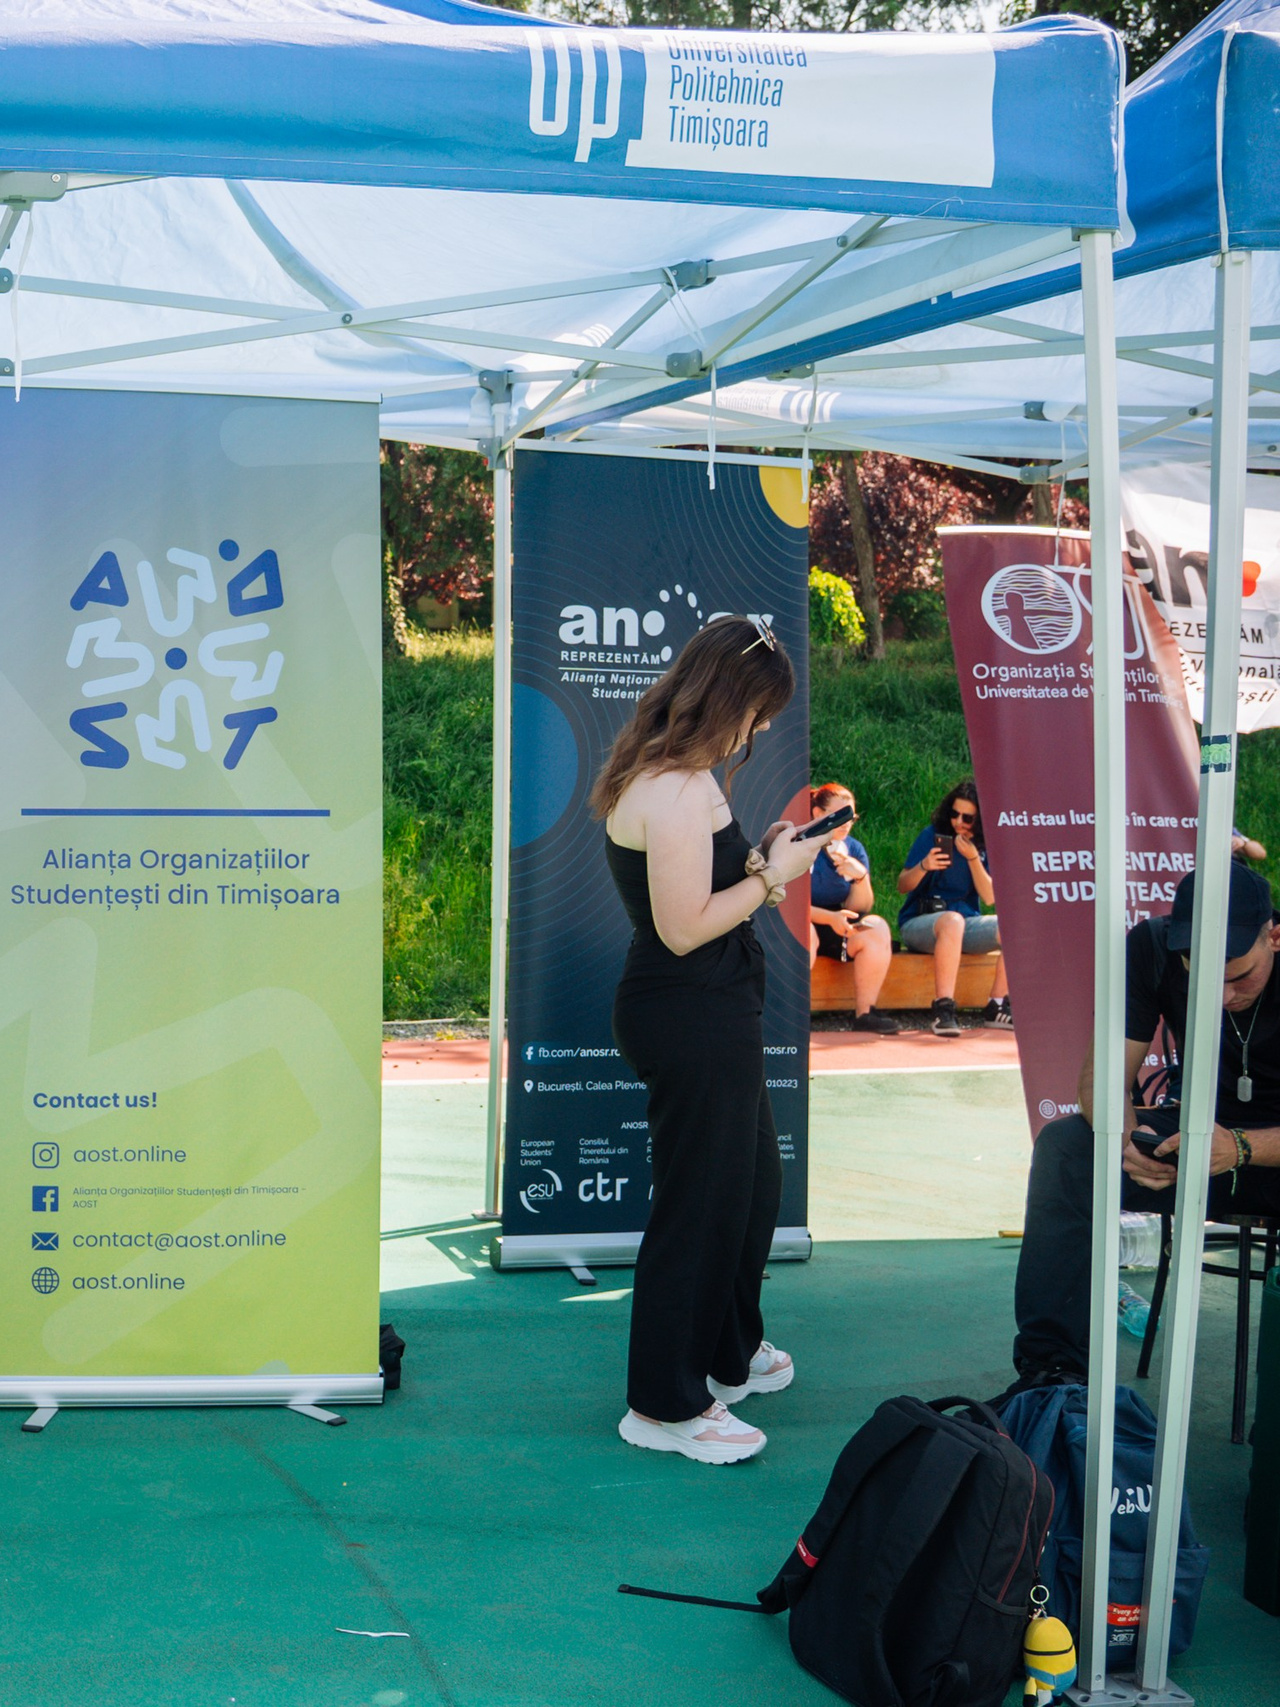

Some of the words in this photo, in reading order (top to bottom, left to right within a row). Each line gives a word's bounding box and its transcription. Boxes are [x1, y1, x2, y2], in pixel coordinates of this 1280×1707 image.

[670, 64, 784, 107] Politehnica
[669, 106, 768, 151] Timișoara
[561, 651, 660, 664] REPREZENTĂM
[561, 672, 605, 685] Alianța
[610, 673, 663, 687] Naționa
[973, 663, 1075, 681] Organizația
[976, 684, 1068, 699] Universitatea
[1072, 684, 1089, 697] de
[997, 811, 1028, 826] Aici
[1032, 812, 1066, 826] stau
[1131, 812, 1146, 827] în
[1149, 815, 1178, 827] care
[43, 849, 131, 875] Alianța
[140, 849, 310, 876] Organizațiilor
[11, 884, 159, 911] Studențești
[168, 884, 208, 905] din
[217, 884, 340, 910] Timișoara
[586, 1080, 613, 1091] Calea
[615, 1079, 647, 1090] Plevne
[766, 1079, 798, 1089] 010223
[33, 1092, 120, 1109] Contact
[125, 1092, 157, 1108] us!
[621, 1121, 649, 1129] ANOSR
[520, 1140, 555, 1149] European
[579, 1138, 609, 1146] Consiliul
[73, 1145, 187, 1163] aost.online
[520, 1158, 542, 1166] Union
[72, 1187, 107, 1197] Alianța
[234, 1185, 249, 1195] din
[578, 1172, 629, 1202] ctr
[72, 1200, 97, 1209] AOST
[73, 1229, 287, 1252] contact@aost.online
[72, 1273, 185, 1290] aost.online
